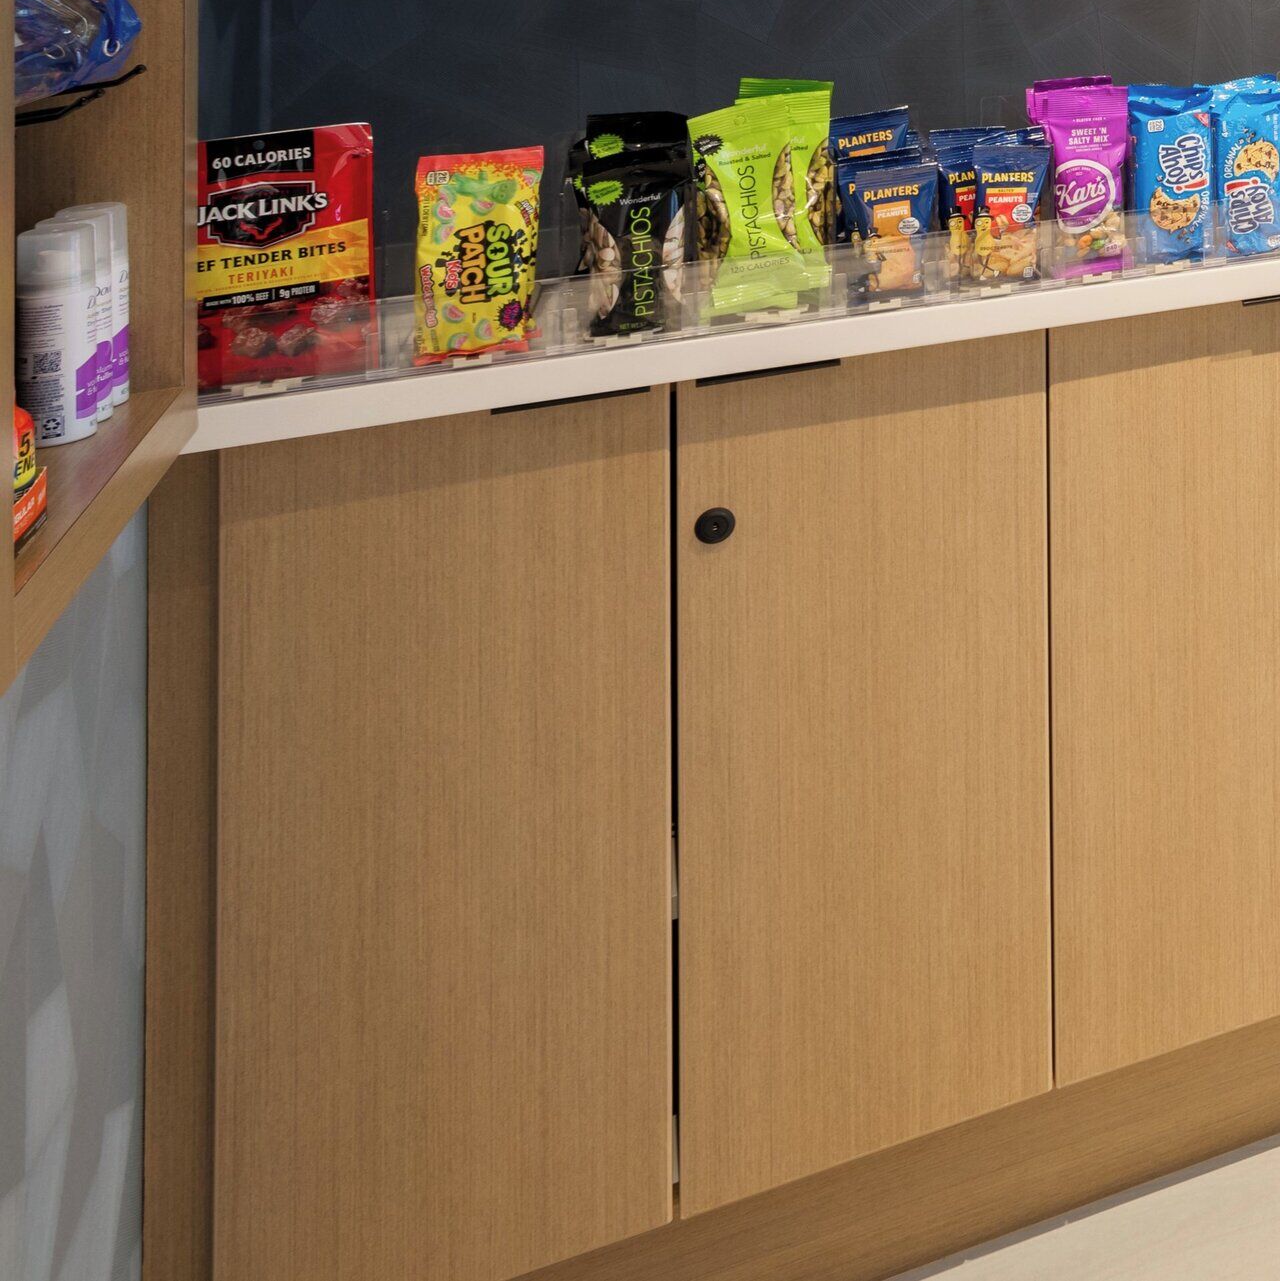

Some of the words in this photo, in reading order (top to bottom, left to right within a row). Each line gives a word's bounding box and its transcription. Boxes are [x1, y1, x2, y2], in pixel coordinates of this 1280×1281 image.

[839, 129, 894, 149] PLANTERS
[1068, 135, 1092, 146] SALTY
[1093, 134, 1109, 143] MIX
[1071, 128, 1095, 138] SWEET
[212, 157, 231, 169] 60
[234, 147, 312, 167] CALORIES
[718, 156, 744, 167] Roasted
[752, 152, 772, 162] Salted
[981, 171, 1035, 184] PLANTERS
[619, 193, 661, 207] Wonderful
[863, 184, 920, 203] PLANTERS
[988, 195, 1023, 204] PEANUTS
[1055, 176, 1106, 208] Kar's
[197, 202, 257, 226] JACK
[258, 192, 328, 216] LINK'S
[737, 164, 767, 261] PISTACHIOS
[221, 249, 292, 270] TENDER
[298, 241, 346, 259] BITES
[460, 224, 490, 305] PATCH
[487, 224, 513, 296] SOUR
[631, 206, 655, 317] PISTACHIOS
[747, 256, 790, 271] CALORIES
[228, 266, 294, 284] TERIYAKI
[446, 258, 461, 290] Kids
[256, 291, 269, 301] BEEF
[279, 288, 290, 298] 9g
[291, 284, 316, 296] PROTEIN
